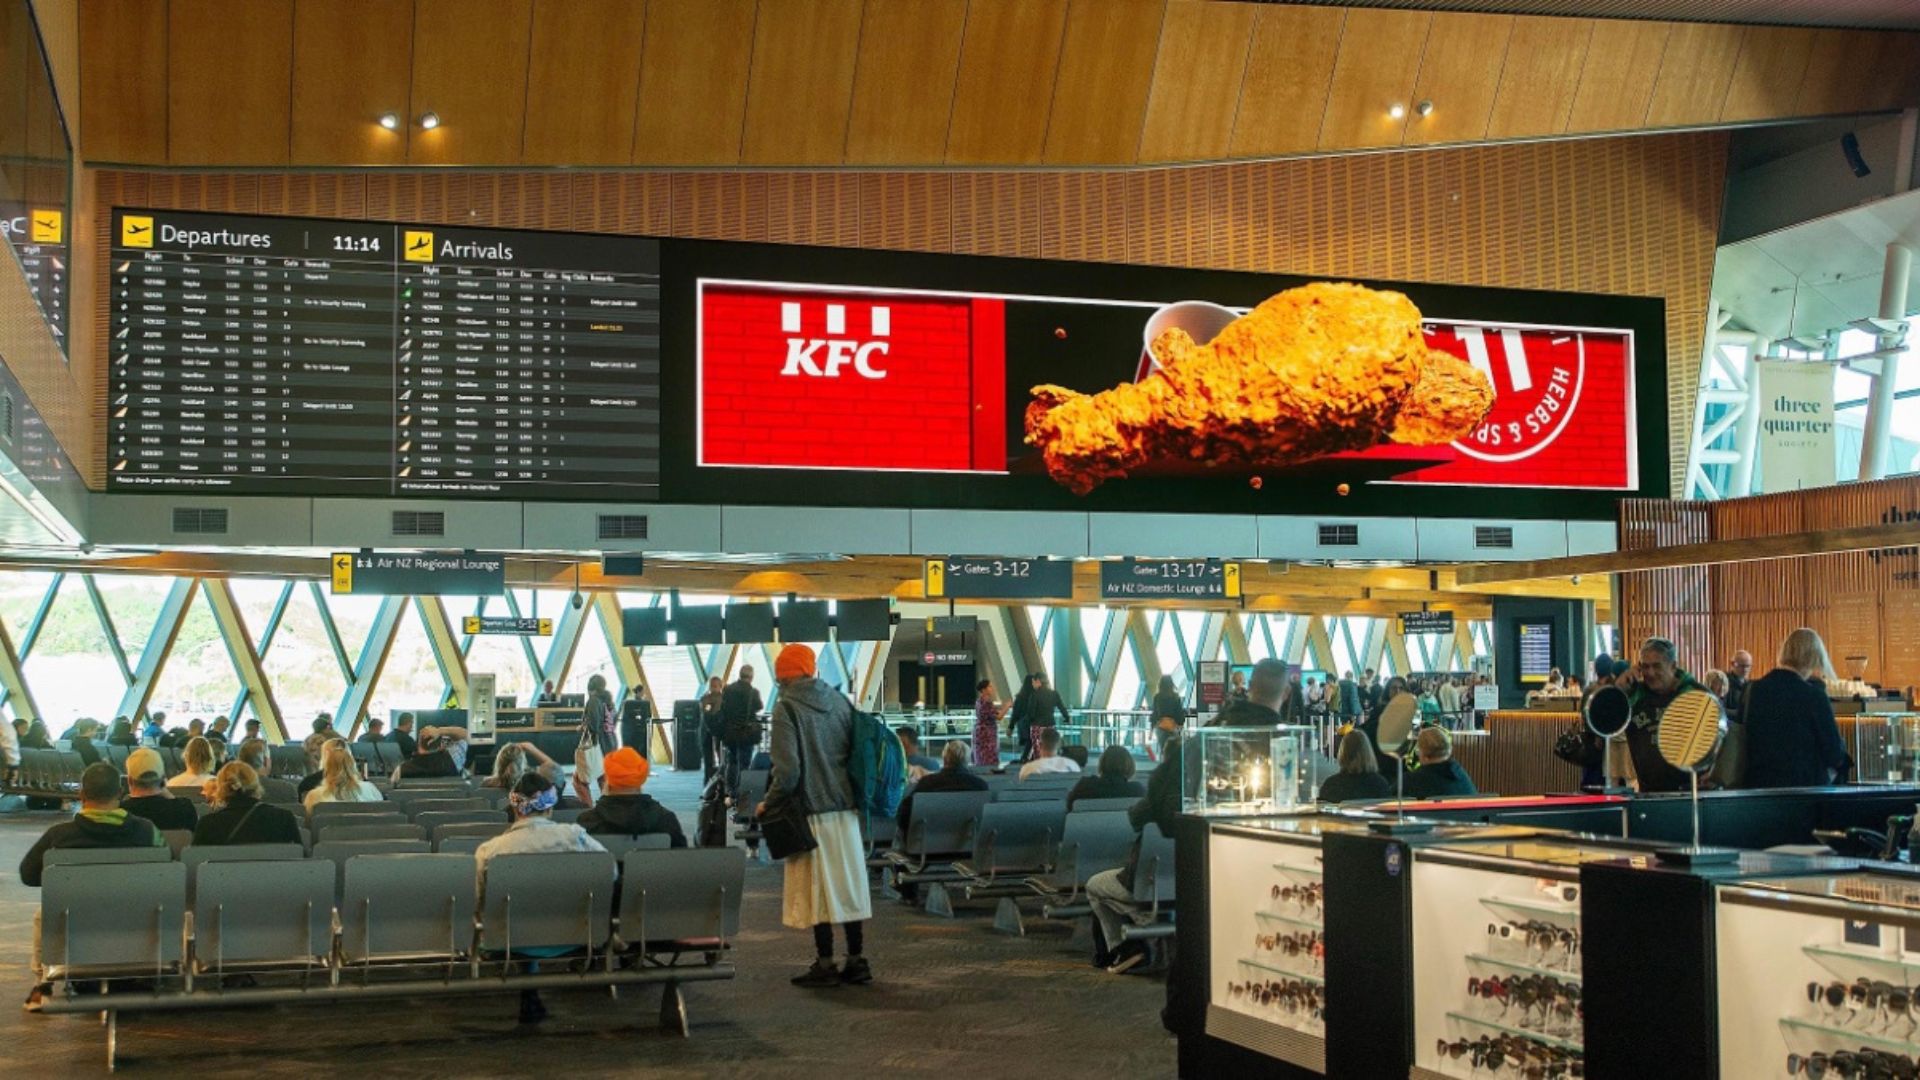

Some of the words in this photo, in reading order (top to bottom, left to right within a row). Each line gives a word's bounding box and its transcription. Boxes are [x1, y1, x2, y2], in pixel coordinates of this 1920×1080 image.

[160, 224, 271, 247] Departures
[333, 235, 380, 252] 11:14
[441, 240, 513, 260] Arrivals
[780, 338, 889, 379] KFC
[1525, 366, 1571, 434] HERBS
[1774, 395, 1821, 414] three
[1469, 421, 1501, 446] SP
[1508, 421, 1523, 444] &
[1764, 419, 1832, 436] quarter
[1882, 505, 1920, 524] thr
[377, 558, 393, 569] Air
[396, 559, 411, 569] NZ
[415, 558, 459, 571] Regional
[463, 560, 499, 572] Lounge
[964, 563, 991, 574] Gates
[993, 560, 1030, 577] 3-12
[1133, 565, 1158, 576] Gates
[1161, 563, 1205, 578] 13-17
[1107, 583, 1120, 593] Air
[1122, 583, 1135, 593] NZ
[1137, 583, 1175, 593] Domestic
[1177, 584, 1205, 595] Lounge
